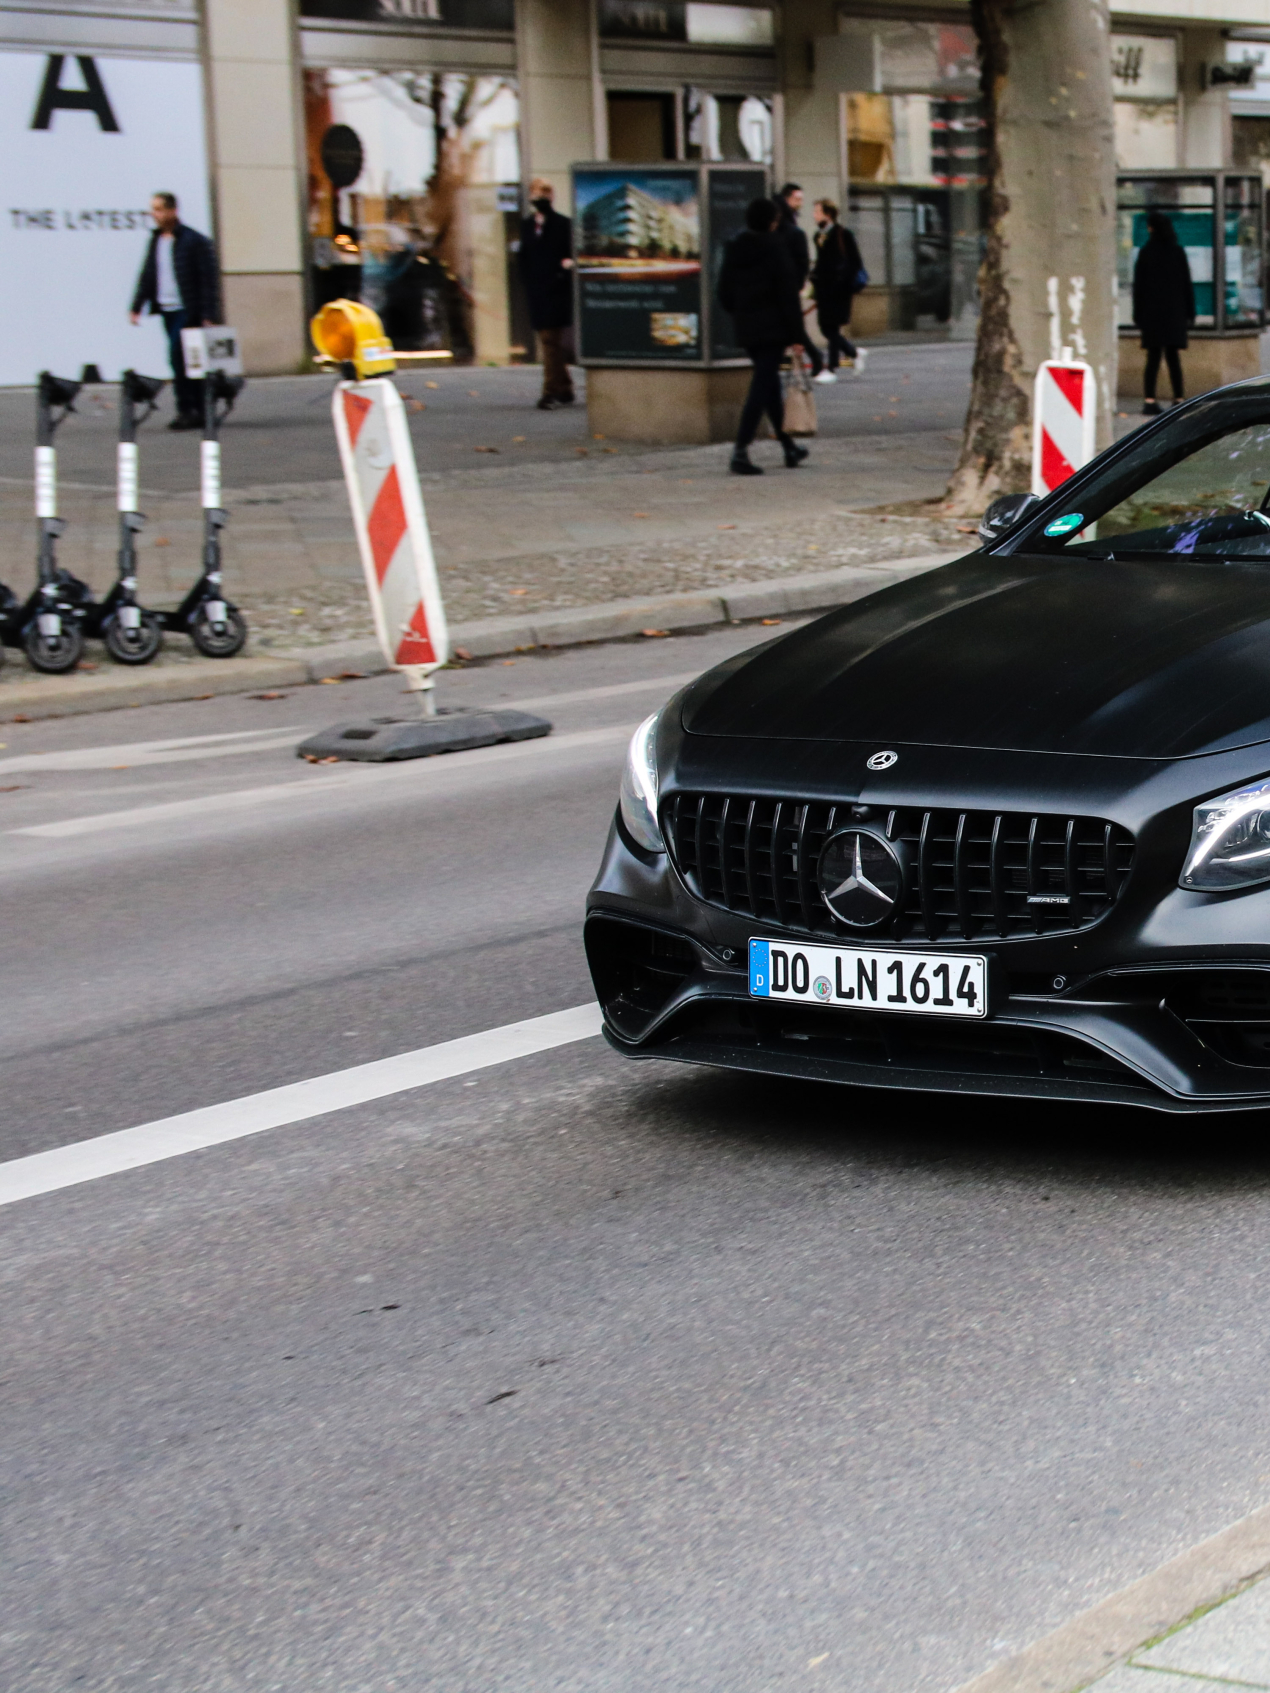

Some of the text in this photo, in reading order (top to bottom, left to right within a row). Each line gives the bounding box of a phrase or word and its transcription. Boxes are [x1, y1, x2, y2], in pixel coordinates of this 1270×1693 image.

[1111, 46, 1143, 85] iff
[30, 54, 121, 132] A
[11, 209, 153, 230] THE LATEST
[770, 949, 978, 1008] DO LN 1614
